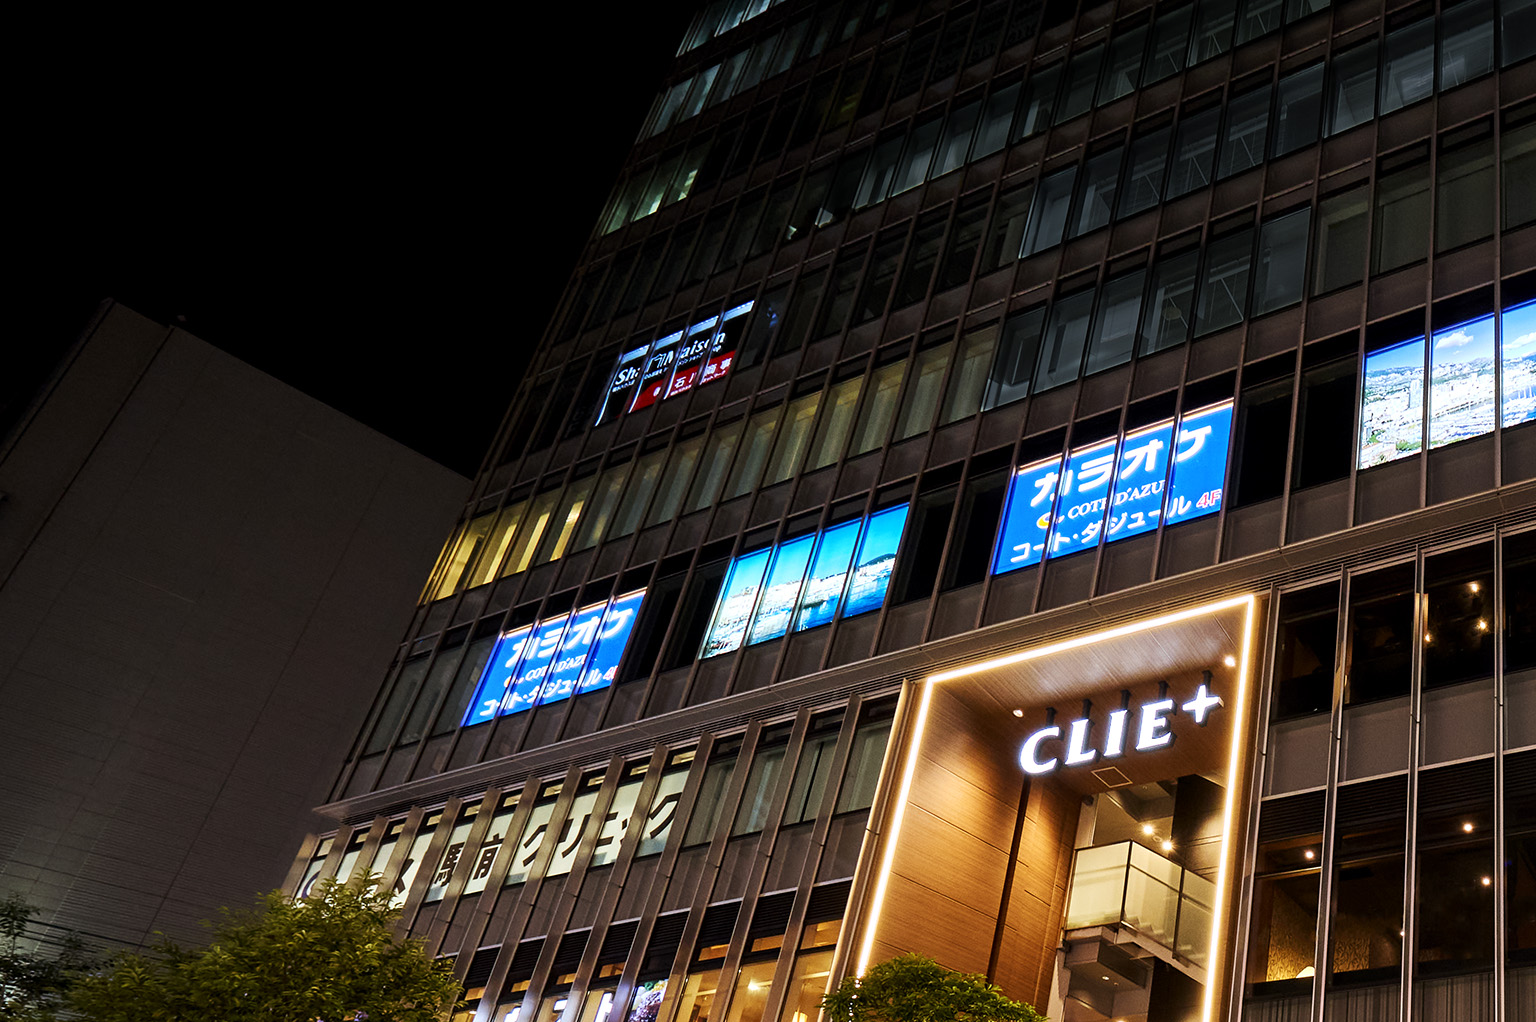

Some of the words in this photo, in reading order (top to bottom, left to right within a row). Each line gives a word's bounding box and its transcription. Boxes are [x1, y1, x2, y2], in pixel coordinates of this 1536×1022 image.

[1030, 425, 1212, 507] カラオケ
[1115, 480, 1175, 506] D'AZU
[1196, 488, 1222, 510] 4F
[505, 608, 633, 668] カラオケ
[1019, 684, 1224, 774] CLIE+
